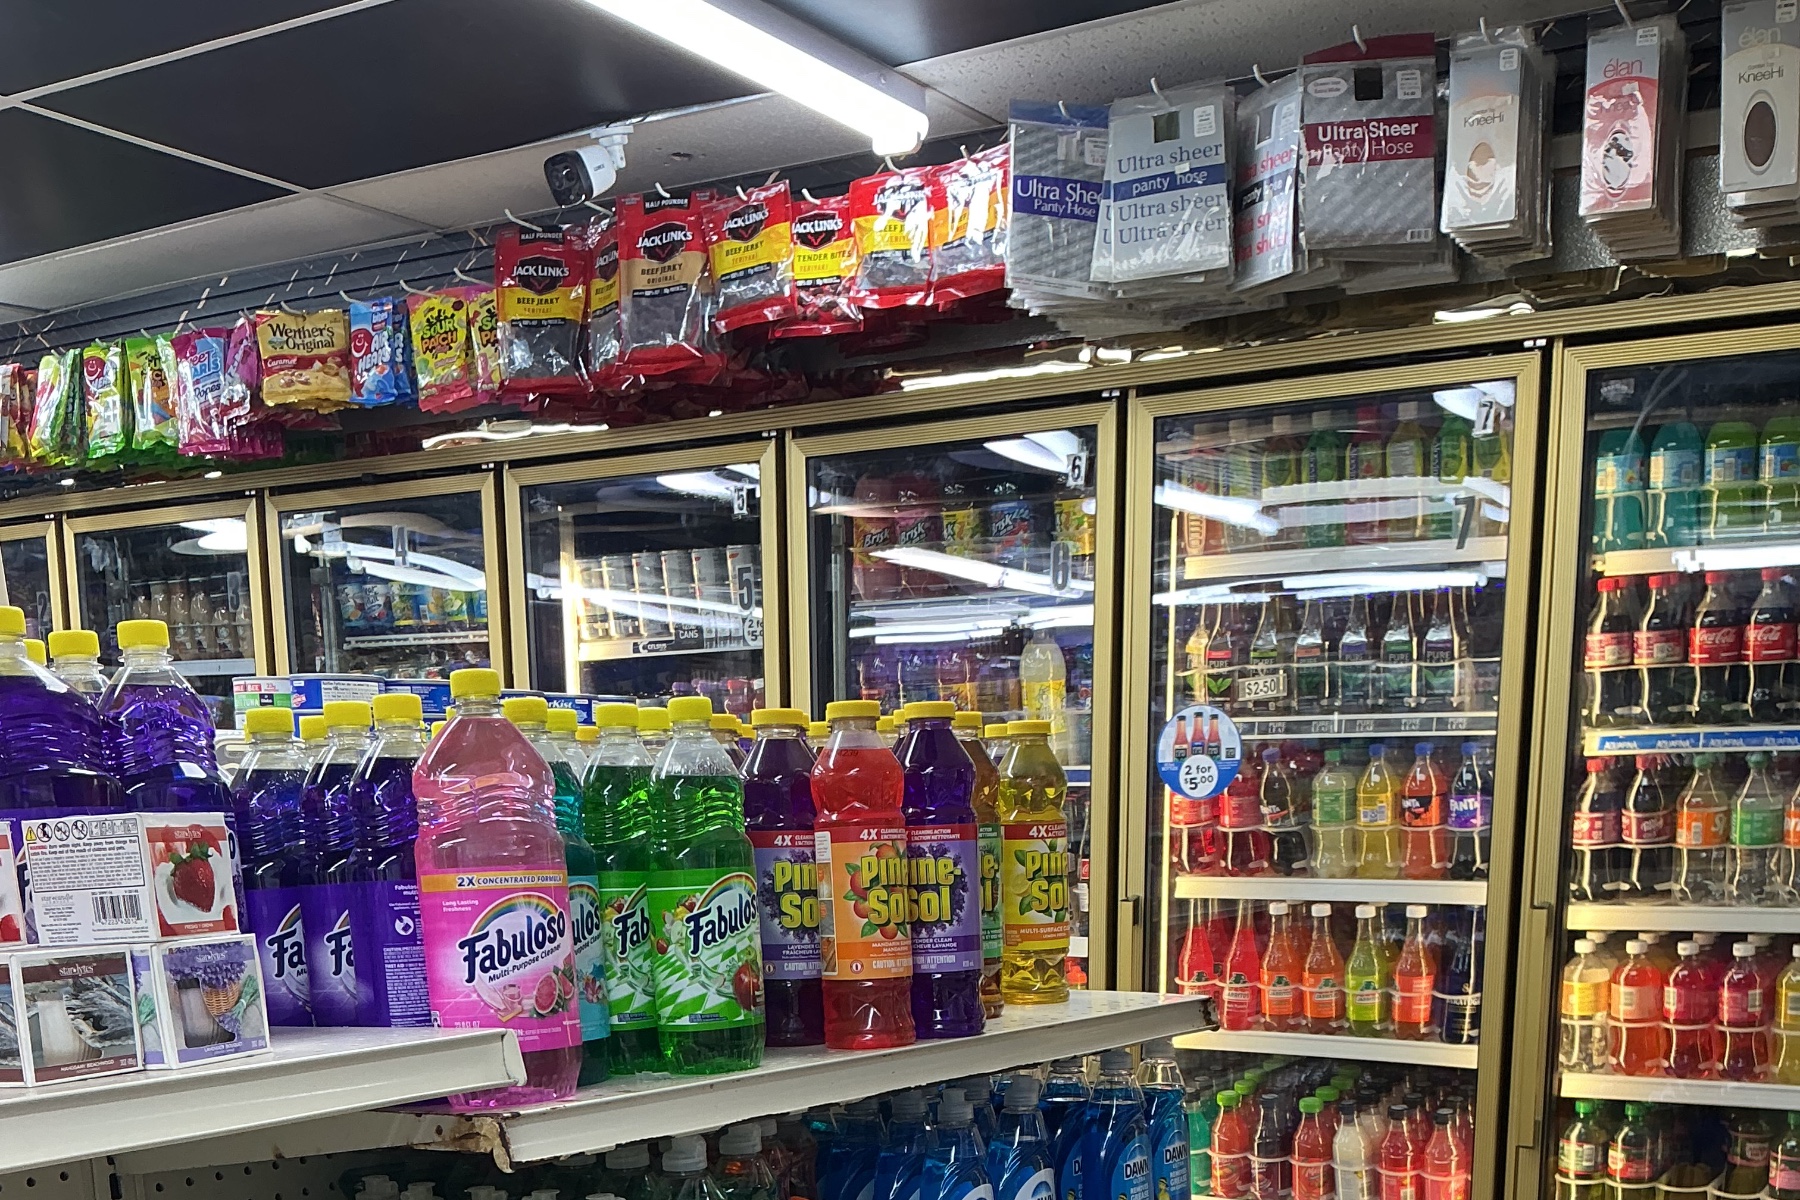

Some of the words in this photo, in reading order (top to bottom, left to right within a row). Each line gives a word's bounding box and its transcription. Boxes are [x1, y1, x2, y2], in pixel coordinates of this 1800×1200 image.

[1604, 57, 1643, 78] élan
[1318, 125, 1363, 141] Ultra
[1369, 121, 1419, 138] Sheer
[1372, 140, 1414, 156] Hose
[1117, 154, 1164, 174] Ultra
[1169, 143, 1223, 165] sheer
[1017, 178, 1060, 201] Ultra
[1132, 176, 1170, 197] panty
[1034, 199, 1066, 217] Panty
[1067, 202, 1096, 218] Hose
[1119, 202, 1165, 222] Ultra
[1119, 225, 1167, 244] Ultra
[797, 252, 828, 262] TENDER
[641, 266, 659, 276] BEEF
[660, 263, 683, 275] JERKY
[268, 323, 335, 340] Werther's
[286, 335, 335, 354] Original
[1071, 455, 1083, 482] 6
[1454, 495, 1477, 550] 7
[1051, 542, 1071, 591] 6
[739, 568, 753, 609] 5
[1427, 650, 1450, 659] PURE
[1184, 765, 1192, 774] 2
[1196, 764, 1212, 774] for
[774, 834, 792, 846] 4X
[860, 828, 878, 840] 4X
[1029, 825, 1048, 838] 4X
[457, 874, 476, 888] 2X
[477, 874, 535, 887] CONCENTRATED
[537, 873, 563, 883] FORMULA
[774, 860, 817, 893] Pin
[458, 908, 566, 984] Fabuloso
[488, 954, 539, 983] Multi-Purpose
[1164, 1144, 1188, 1163] DAWN
[1124, 1158, 1149, 1179] DAWN
